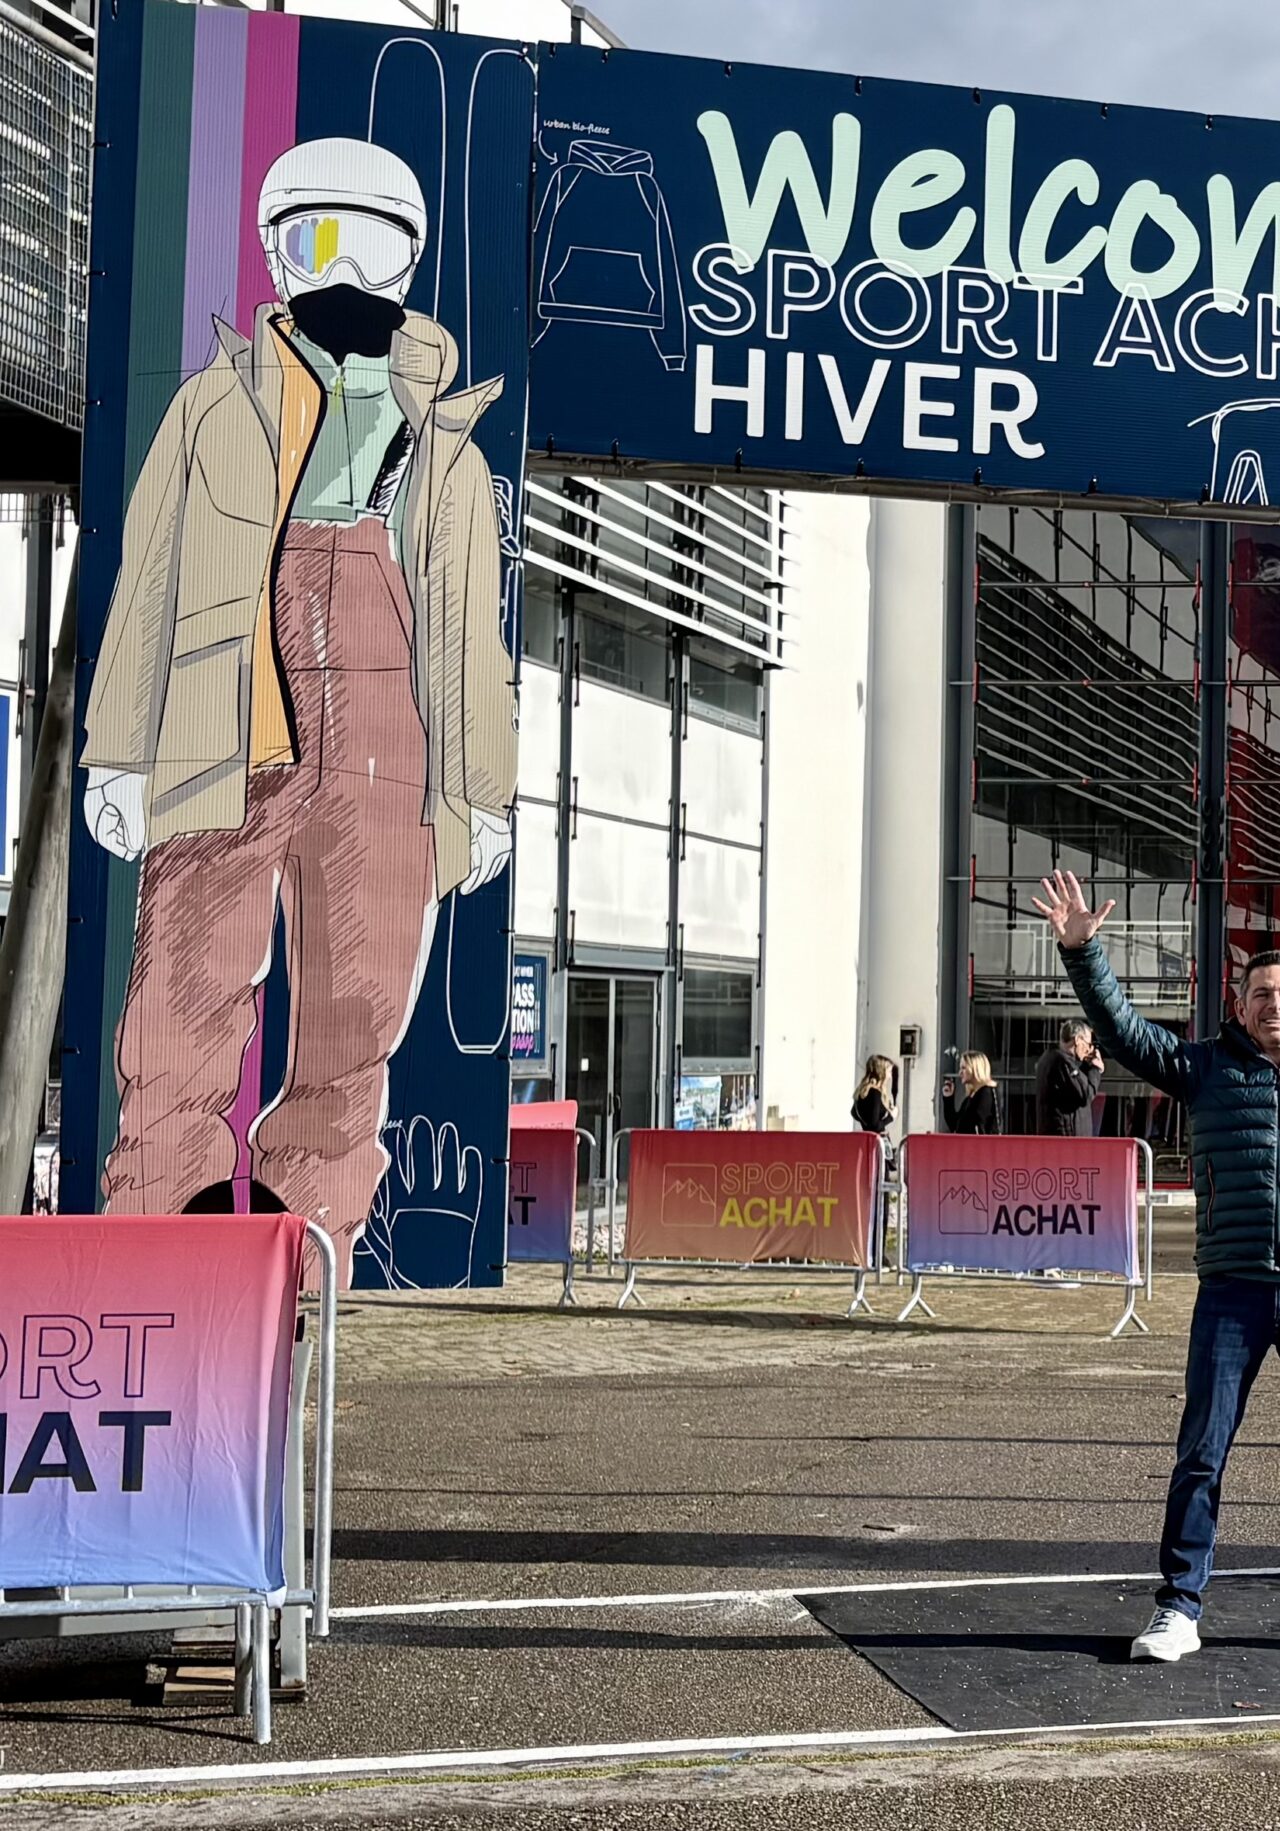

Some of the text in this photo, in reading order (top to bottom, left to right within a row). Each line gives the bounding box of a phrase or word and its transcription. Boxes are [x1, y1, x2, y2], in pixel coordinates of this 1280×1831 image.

[688, 242, 1084, 362] SPORT
[694, 343, 1046, 460] HIVER
[512, 982, 535, 1008] ASS
[720, 1162, 840, 1196] SPORT
[992, 1167, 1101, 1201] SPORT
[719, 1196, 839, 1229] ACHAT
[992, 1203, 1102, 1237] ACHAT
[0, 1313, 176, 1400] RT
[0, 1411, 172, 1495] AT
